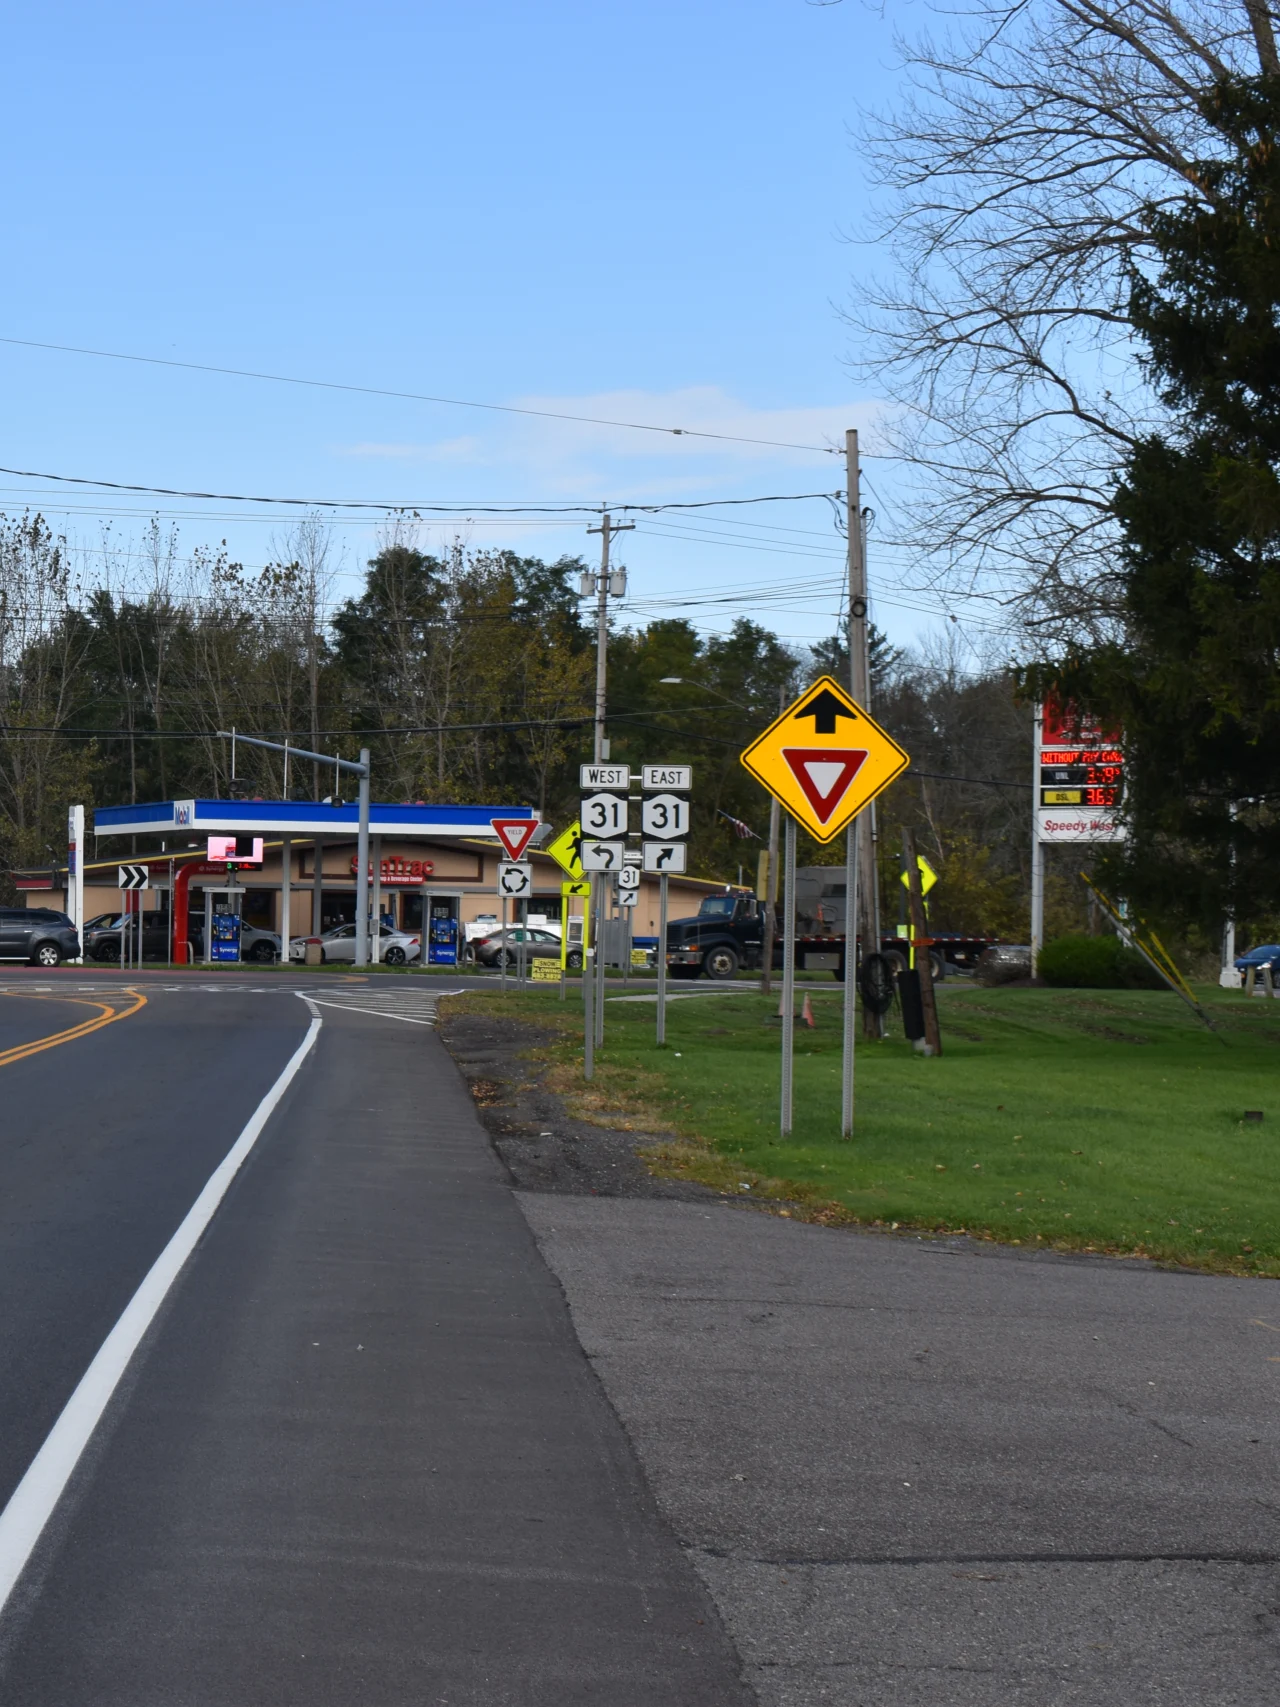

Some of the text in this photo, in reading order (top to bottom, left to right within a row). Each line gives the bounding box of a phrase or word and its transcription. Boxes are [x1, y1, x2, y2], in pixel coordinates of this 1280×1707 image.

[1042, 752, 1079, 763] WITHOUT
[588, 769, 622, 784] WEST
[651, 769, 683, 784] EAST
[589, 802, 619, 828] 31
[651, 803, 680, 829] 31
[1044, 819, 1087, 833] Speedy
[622, 870, 636, 884] 31
